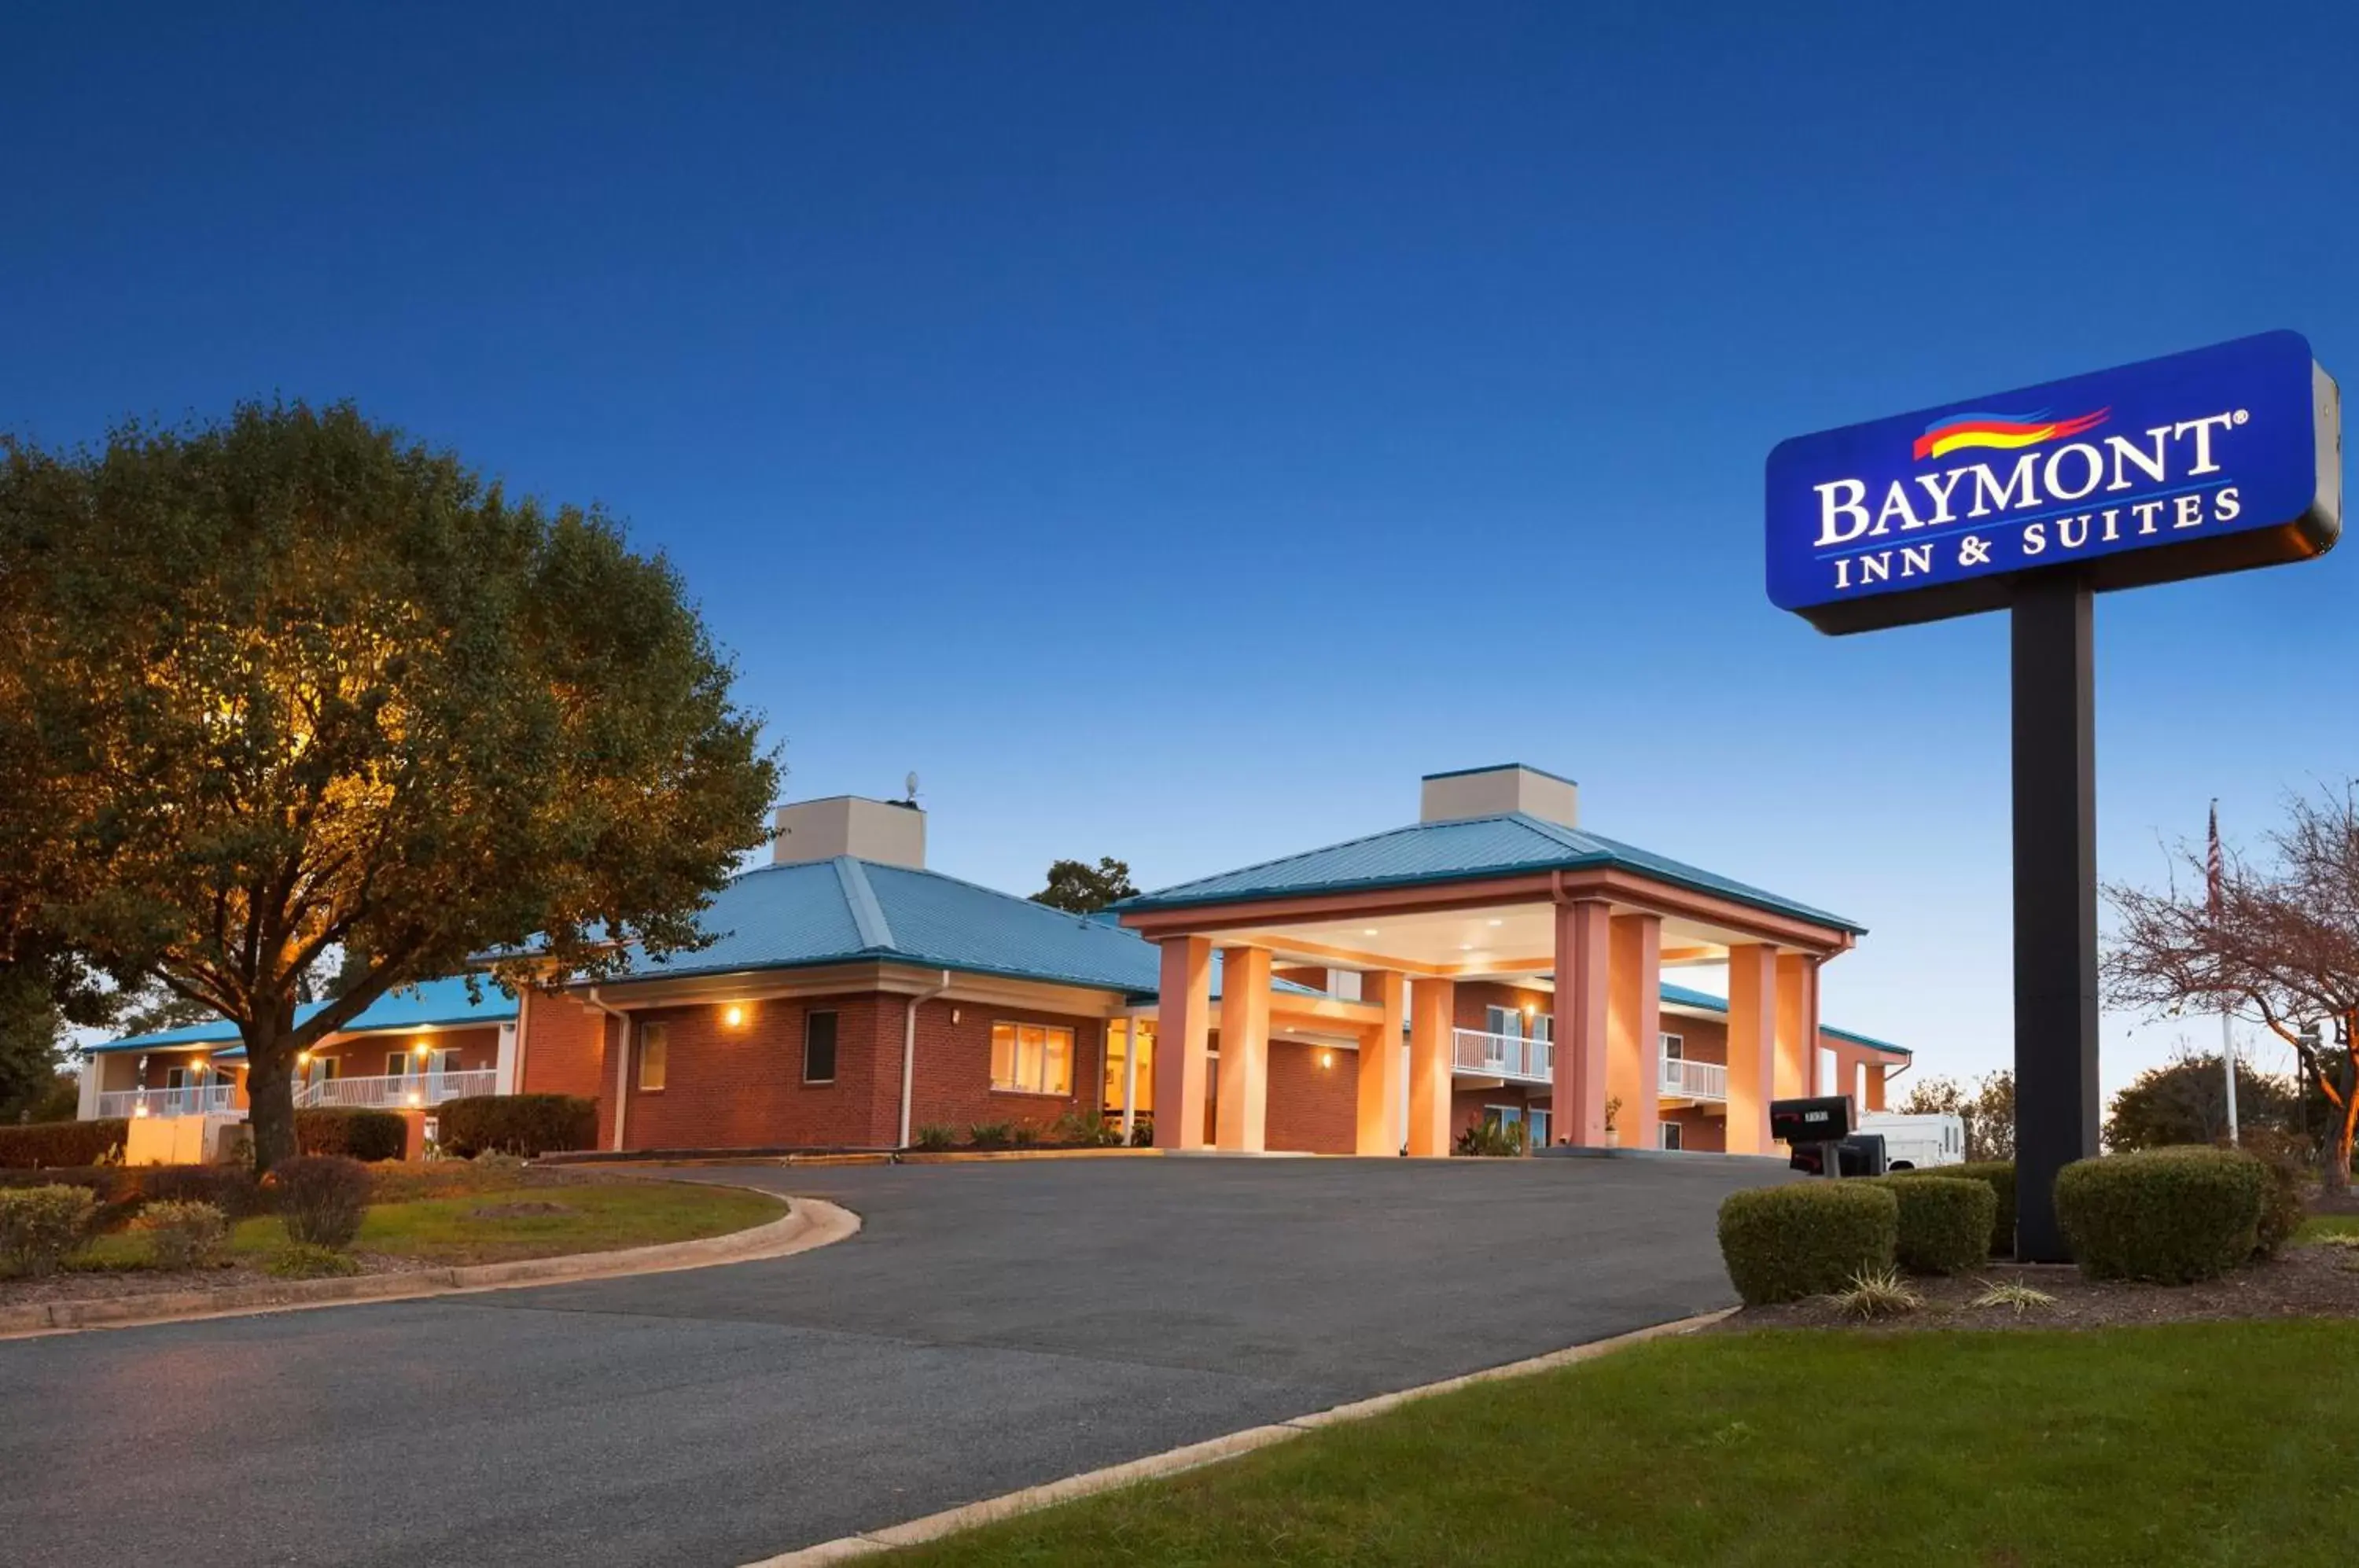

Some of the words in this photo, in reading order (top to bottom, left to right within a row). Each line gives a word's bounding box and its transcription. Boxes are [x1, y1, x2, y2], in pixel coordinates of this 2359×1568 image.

[1835, 543, 1934, 589] INN
[1958, 536, 1993, 566] &
[2022, 488, 2241, 554] SUITES
